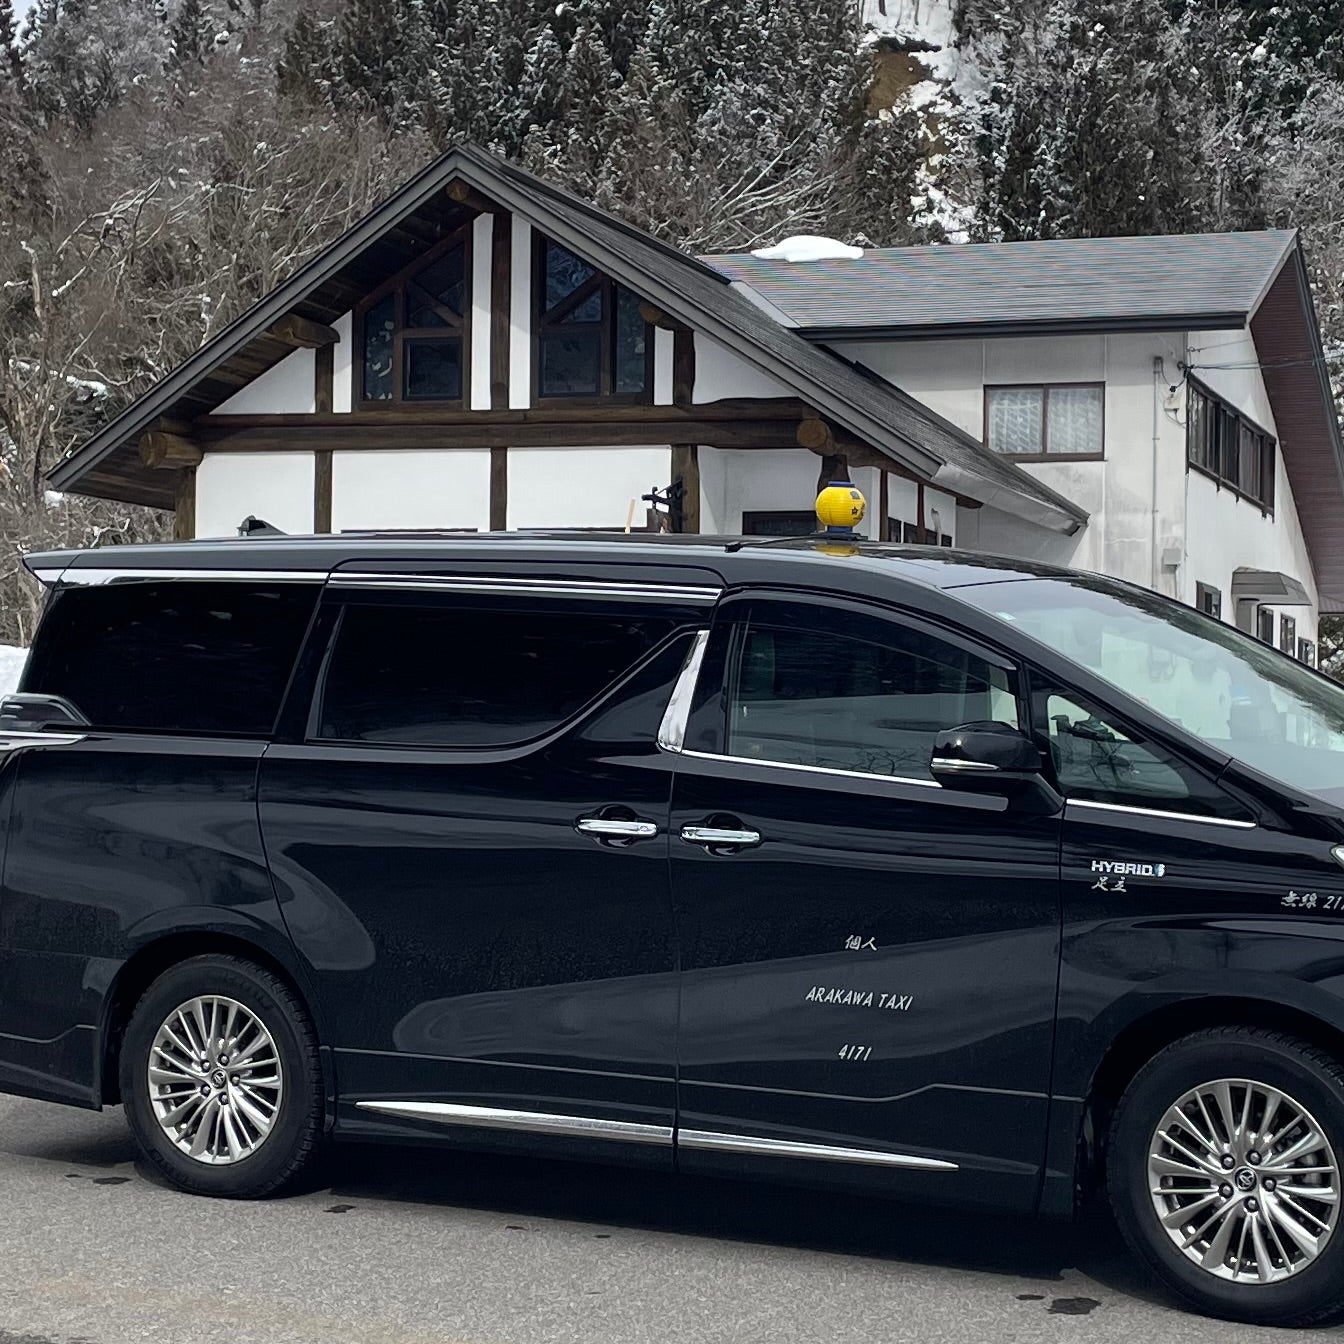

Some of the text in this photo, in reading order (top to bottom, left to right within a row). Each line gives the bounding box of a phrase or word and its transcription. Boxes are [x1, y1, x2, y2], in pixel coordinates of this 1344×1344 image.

[1090, 860, 1154, 877] HYBRID
[1090, 876, 1128, 893] 足立
[844, 934, 878, 951] 個人
[805, 986, 914, 1011] ARAKAWA TAXI
[838, 1044, 873, 1062] 4171
